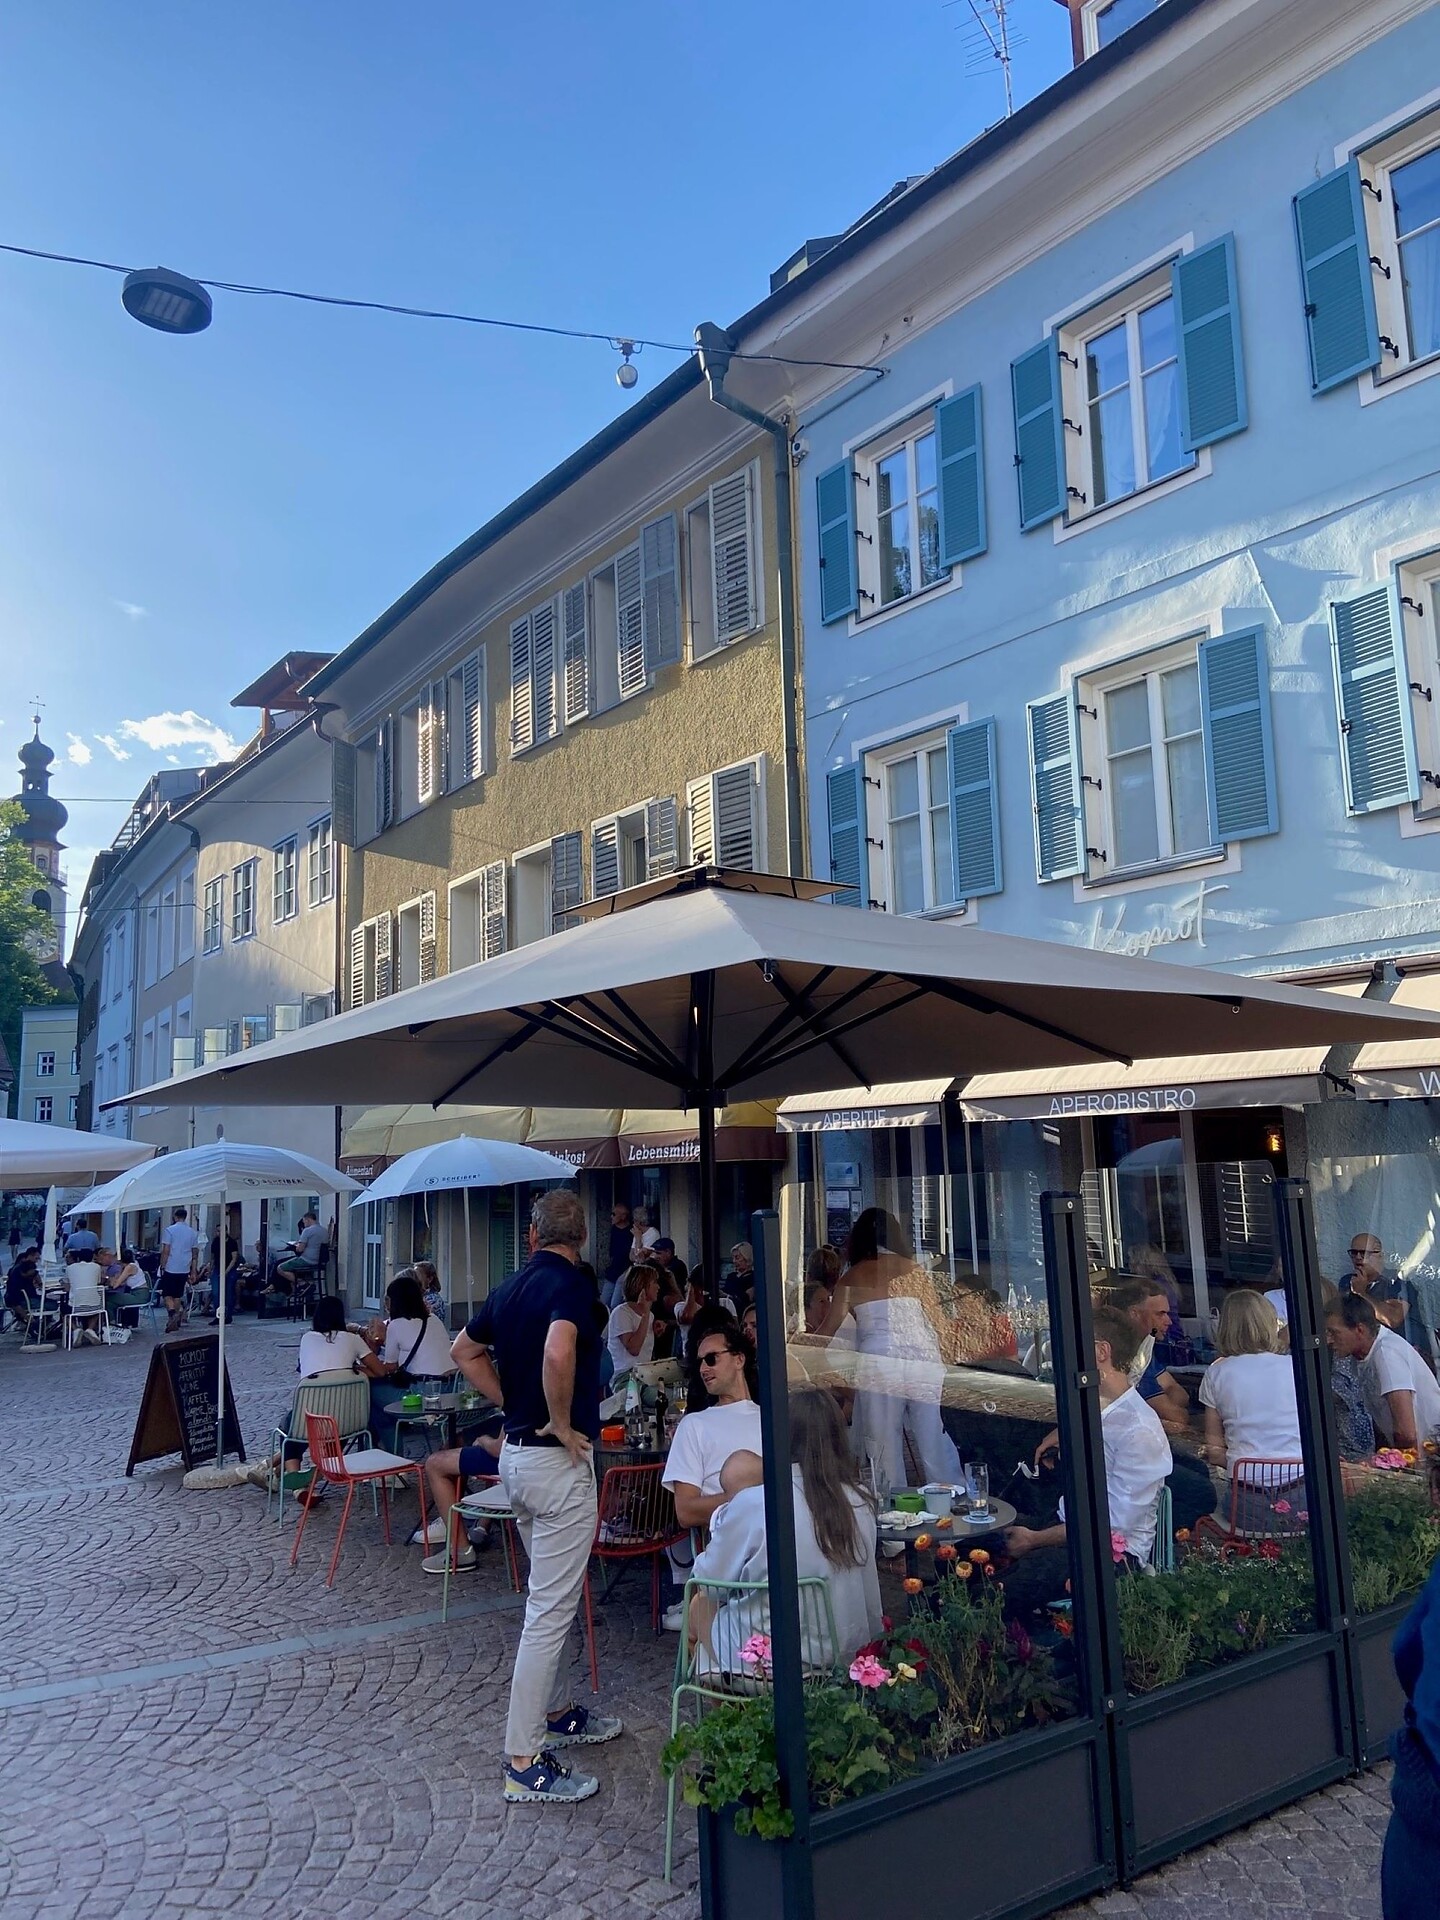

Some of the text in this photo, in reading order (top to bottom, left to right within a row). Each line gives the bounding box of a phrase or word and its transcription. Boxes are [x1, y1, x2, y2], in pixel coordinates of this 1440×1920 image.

[1049, 1088, 1196, 1116] APEROBISTRO
[823, 1110, 887, 1129] APERITIF
[628, 1140, 700, 1161] Lebensmitte
